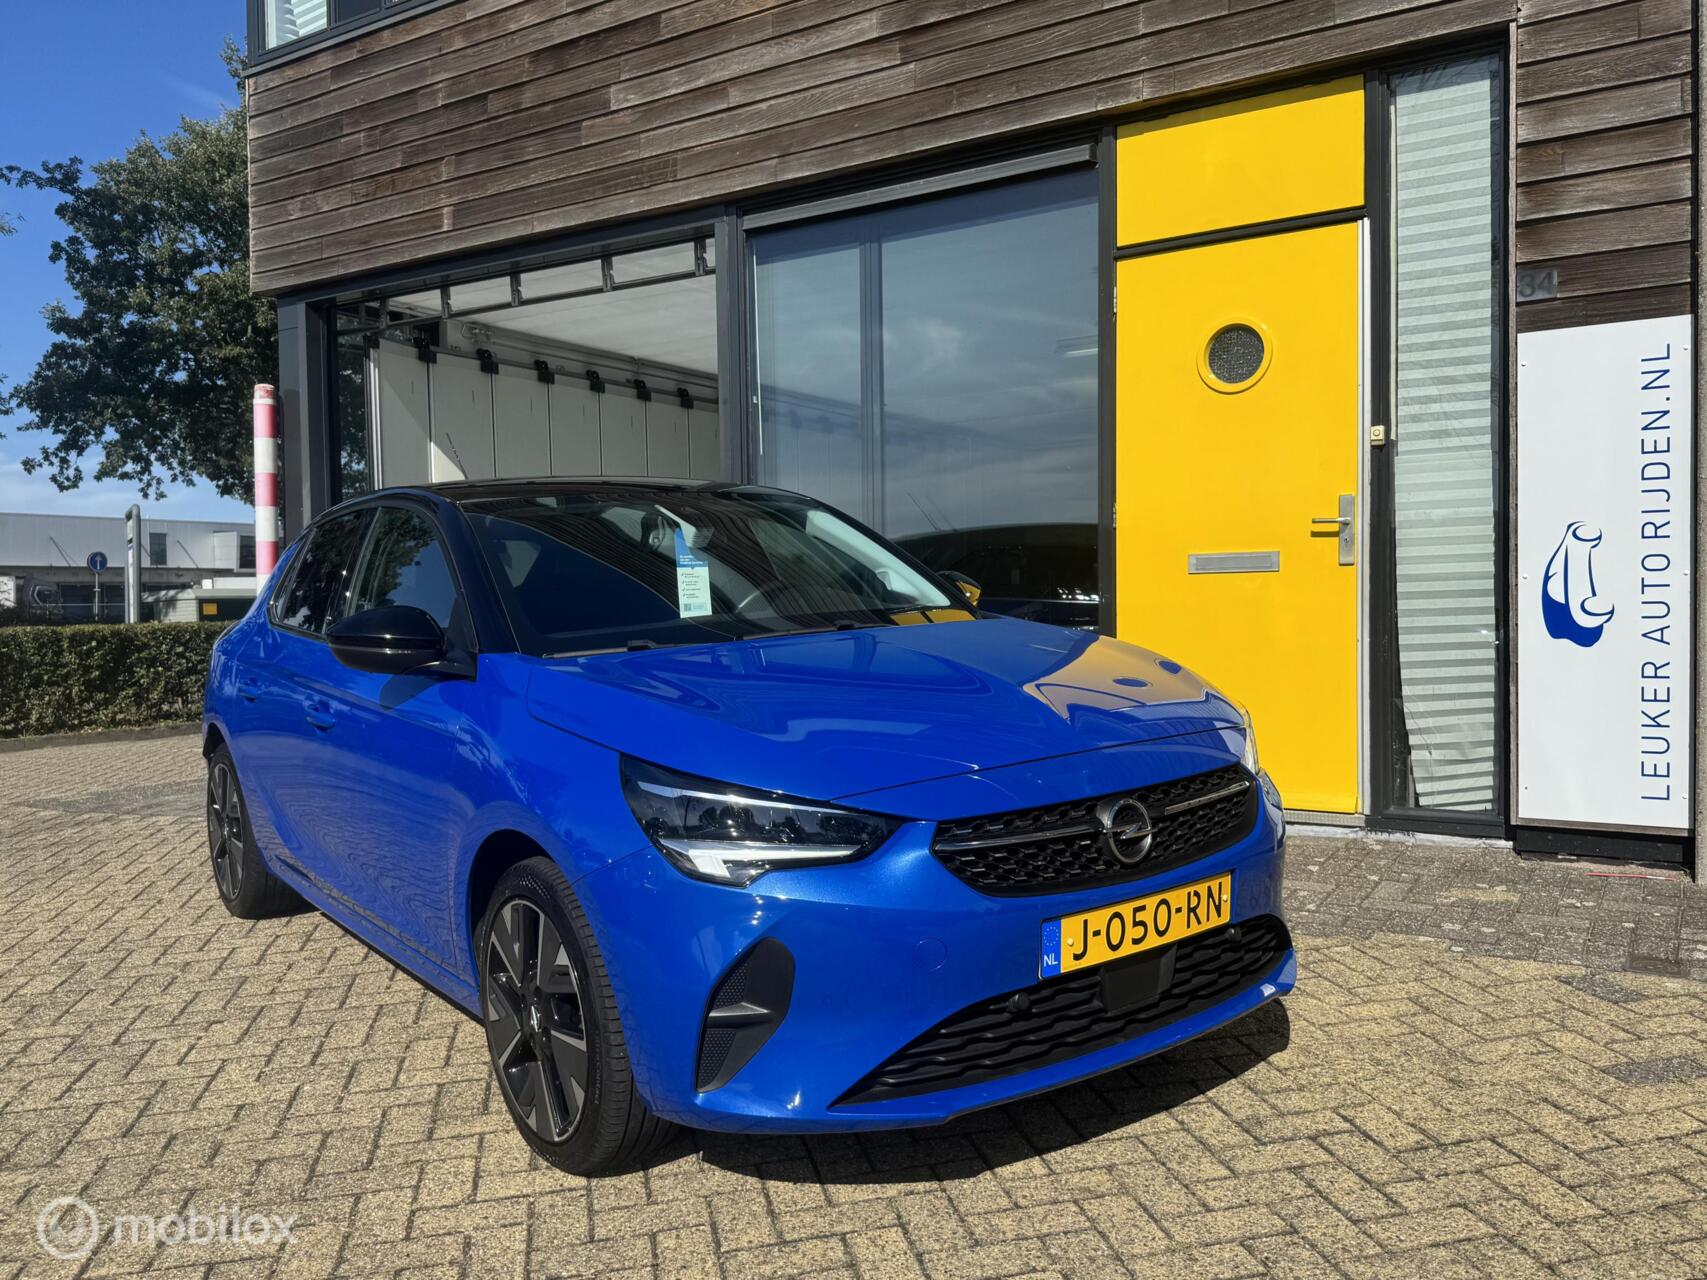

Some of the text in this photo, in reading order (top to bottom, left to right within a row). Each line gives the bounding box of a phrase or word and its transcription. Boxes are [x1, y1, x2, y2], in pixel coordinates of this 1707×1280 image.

[1641, 661, 1671, 801] LEUKER
[1043, 953, 1059, 968] NL
[1072, 881, 1223, 962] J-050-RN
